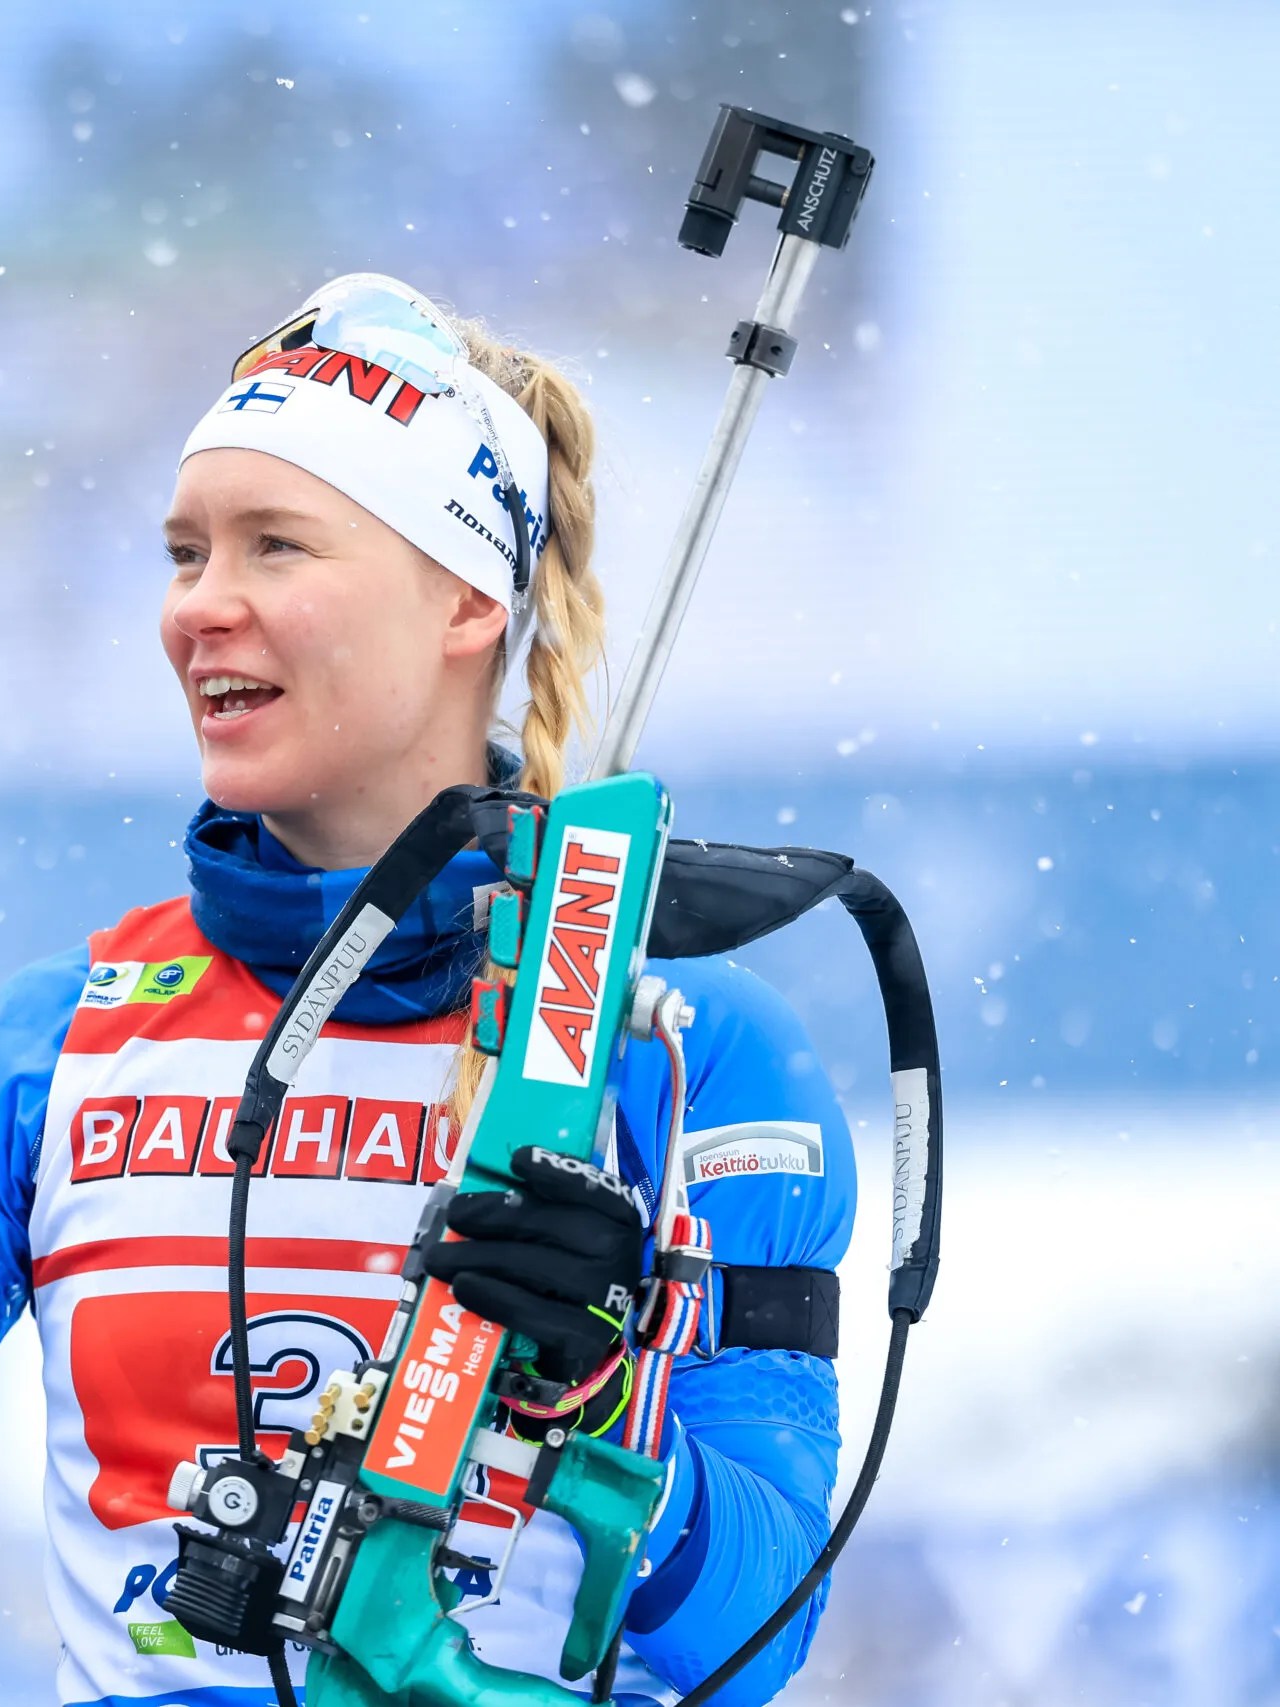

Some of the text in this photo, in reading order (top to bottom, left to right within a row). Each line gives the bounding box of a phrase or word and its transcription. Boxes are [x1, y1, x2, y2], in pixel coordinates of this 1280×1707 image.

[443, 497, 518, 580] nonam
[281, 930, 368, 1060] SYDÄNPUU
[538, 841, 621, 1079] AVANT
[79, 1105, 456, 1173] BAUHAU
[699, 1148, 740, 1163] Joensuun
[699, 1152, 805, 1178] Keittiötukku
[384, 1286, 470, 1469] VIESSMA
[462, 1334, 489, 1377] Heat
[289, 1497, 334, 1582] Patria
[136, 1625, 164, 1636] FEEL
